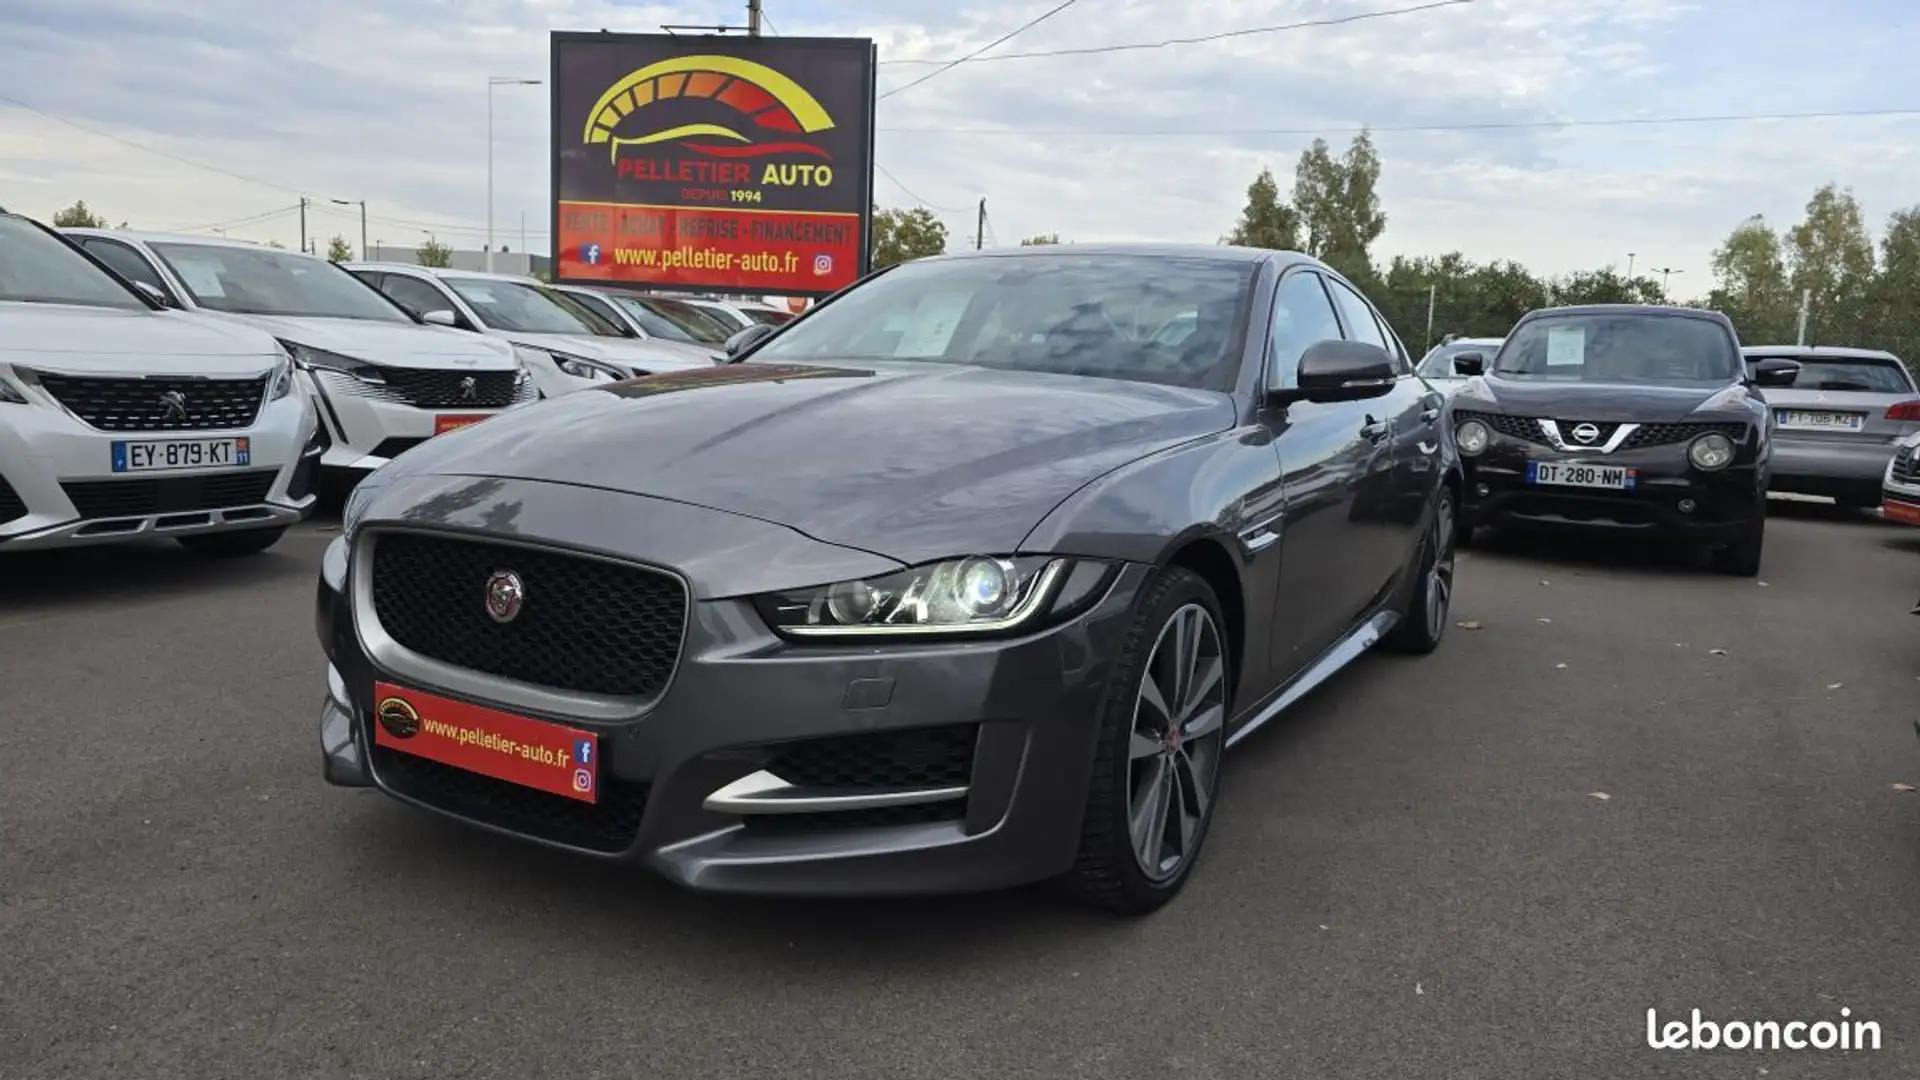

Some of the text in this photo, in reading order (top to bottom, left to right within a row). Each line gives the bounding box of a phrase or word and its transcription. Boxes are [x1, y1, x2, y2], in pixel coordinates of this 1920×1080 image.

[616, 157, 833, 187] PELLETIER AUTO
[730, 189, 762, 204] 1994
[679, 215, 739, 240] REPRISE
[751, 219, 854, 246] FINANCEMENT
[614, 246, 799, 274] www.pelletier-auto.fr
[131, 441, 232, 467] EY-879-KT
[1539, 464, 1623, 486] DT-280-NM
[423, 717, 570, 769] www.pelletier-auto.fr
